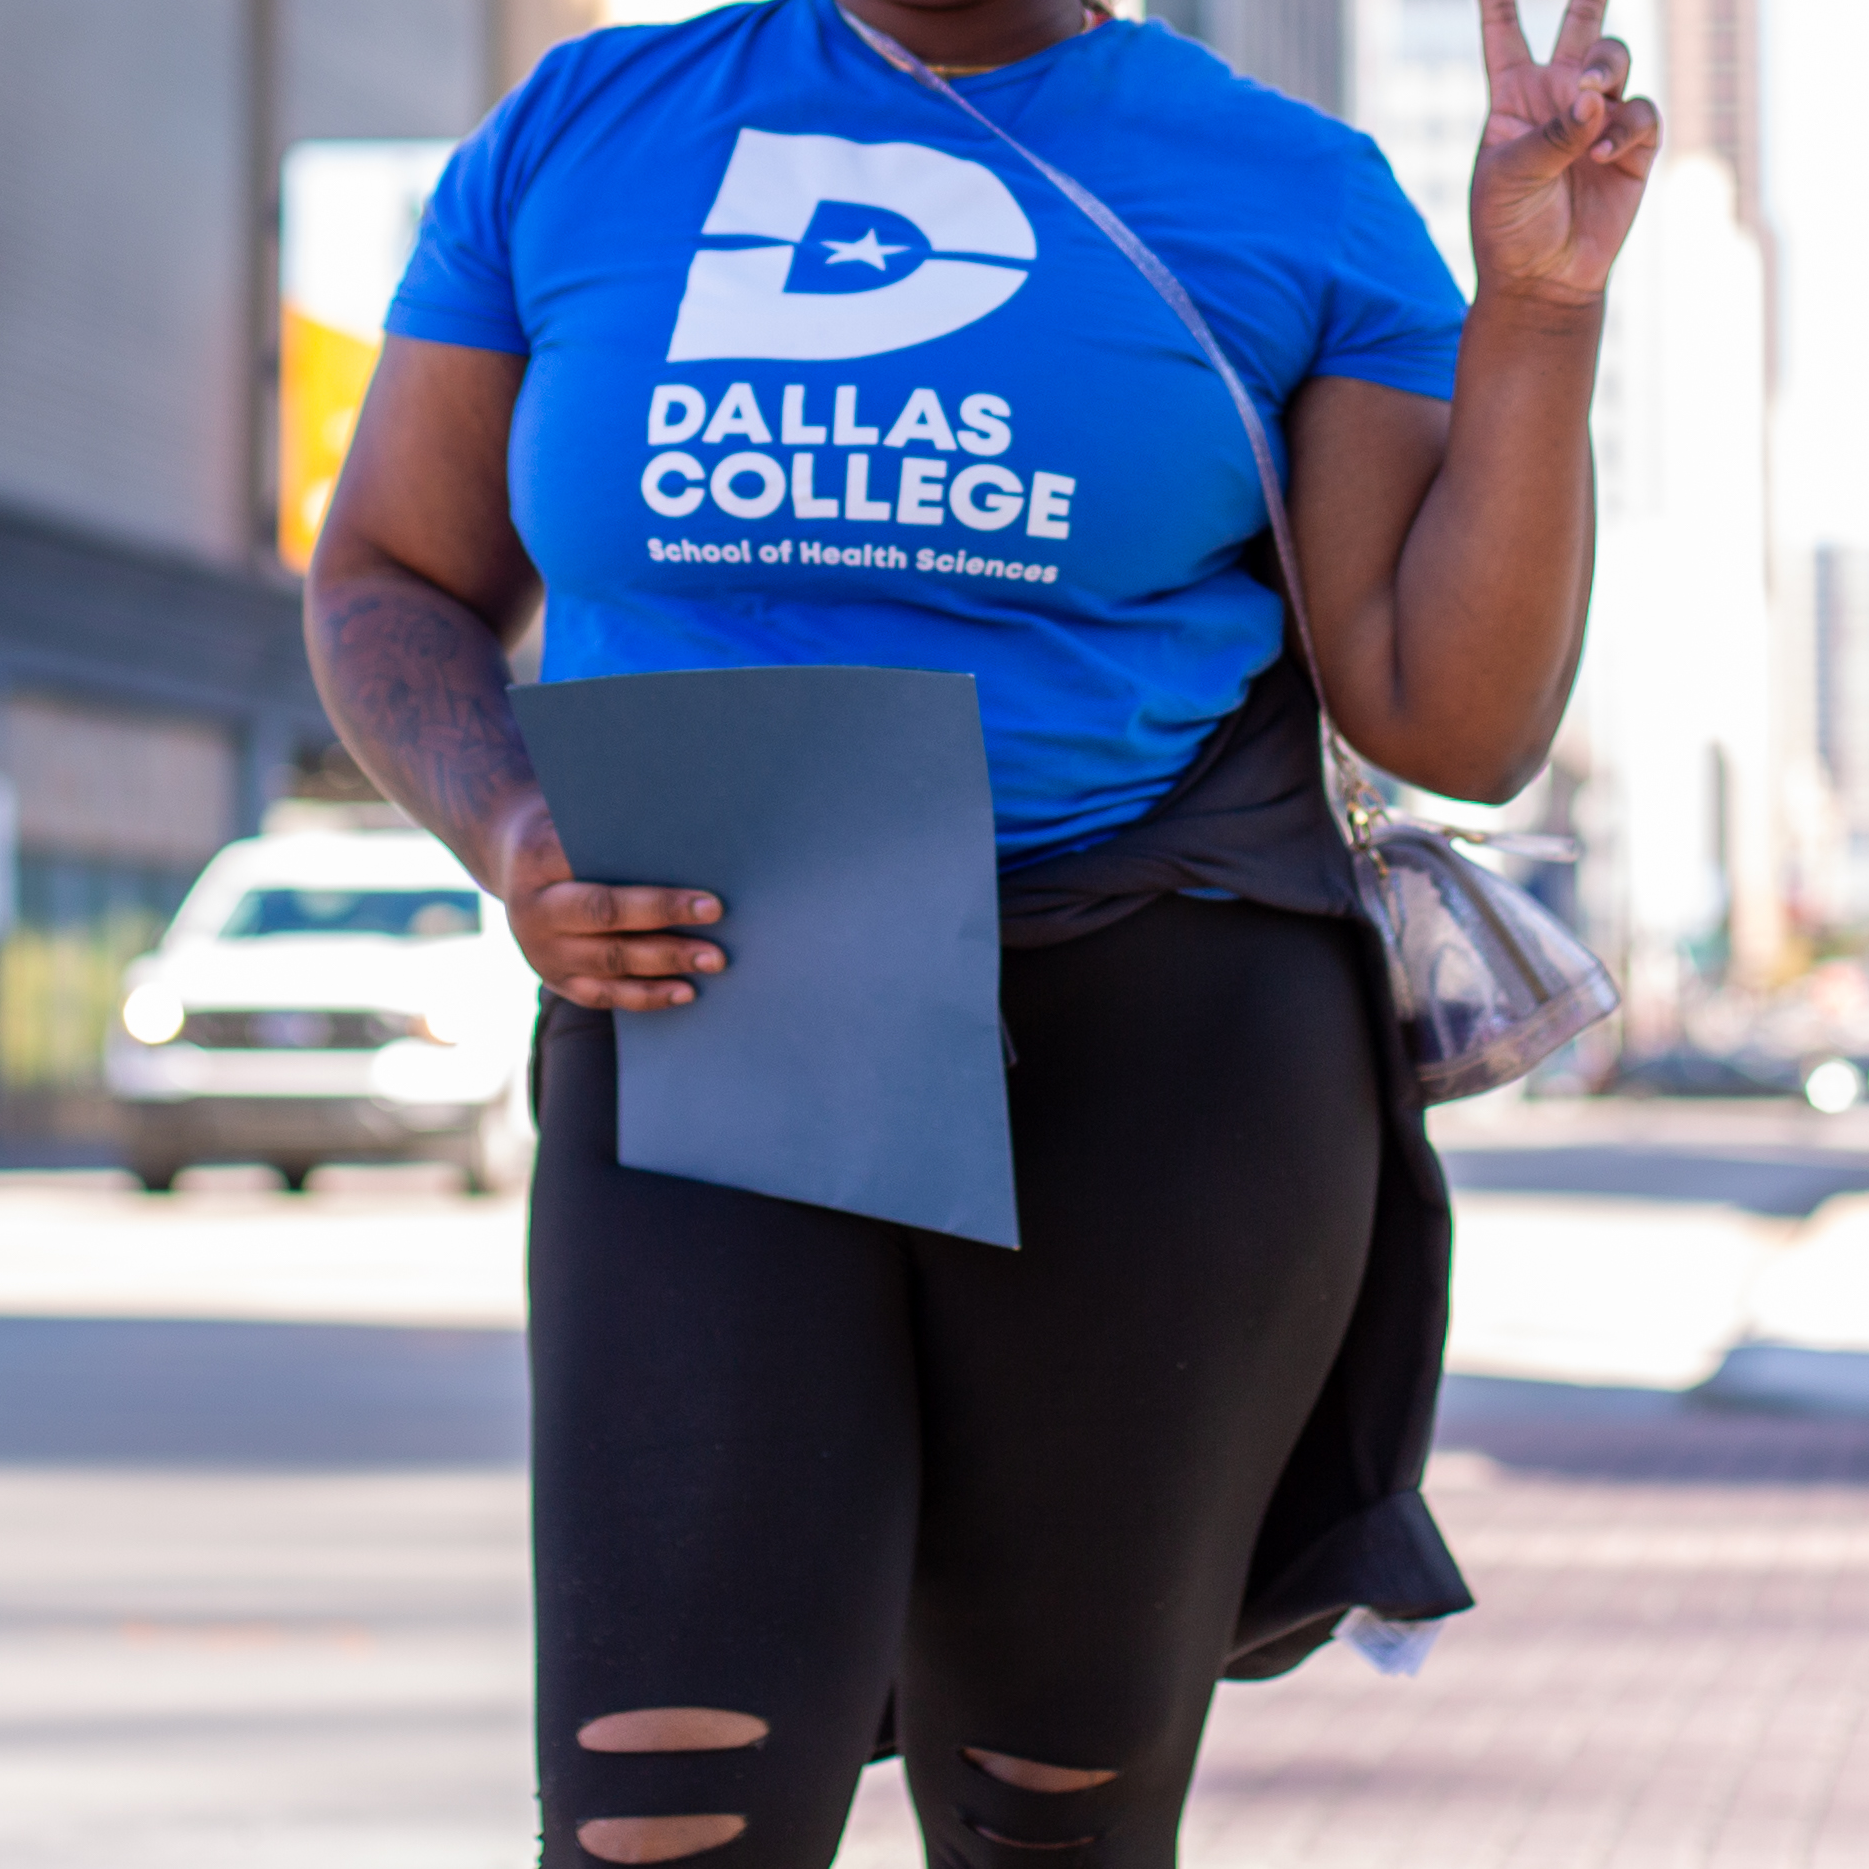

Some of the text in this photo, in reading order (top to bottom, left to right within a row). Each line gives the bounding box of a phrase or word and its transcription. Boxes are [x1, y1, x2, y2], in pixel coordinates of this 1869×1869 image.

[647, 382, 1013, 456] DALLAS
[640, 450, 1077, 540] COLLEGE
[647, 538, 1059, 584] School of Health Sciences
